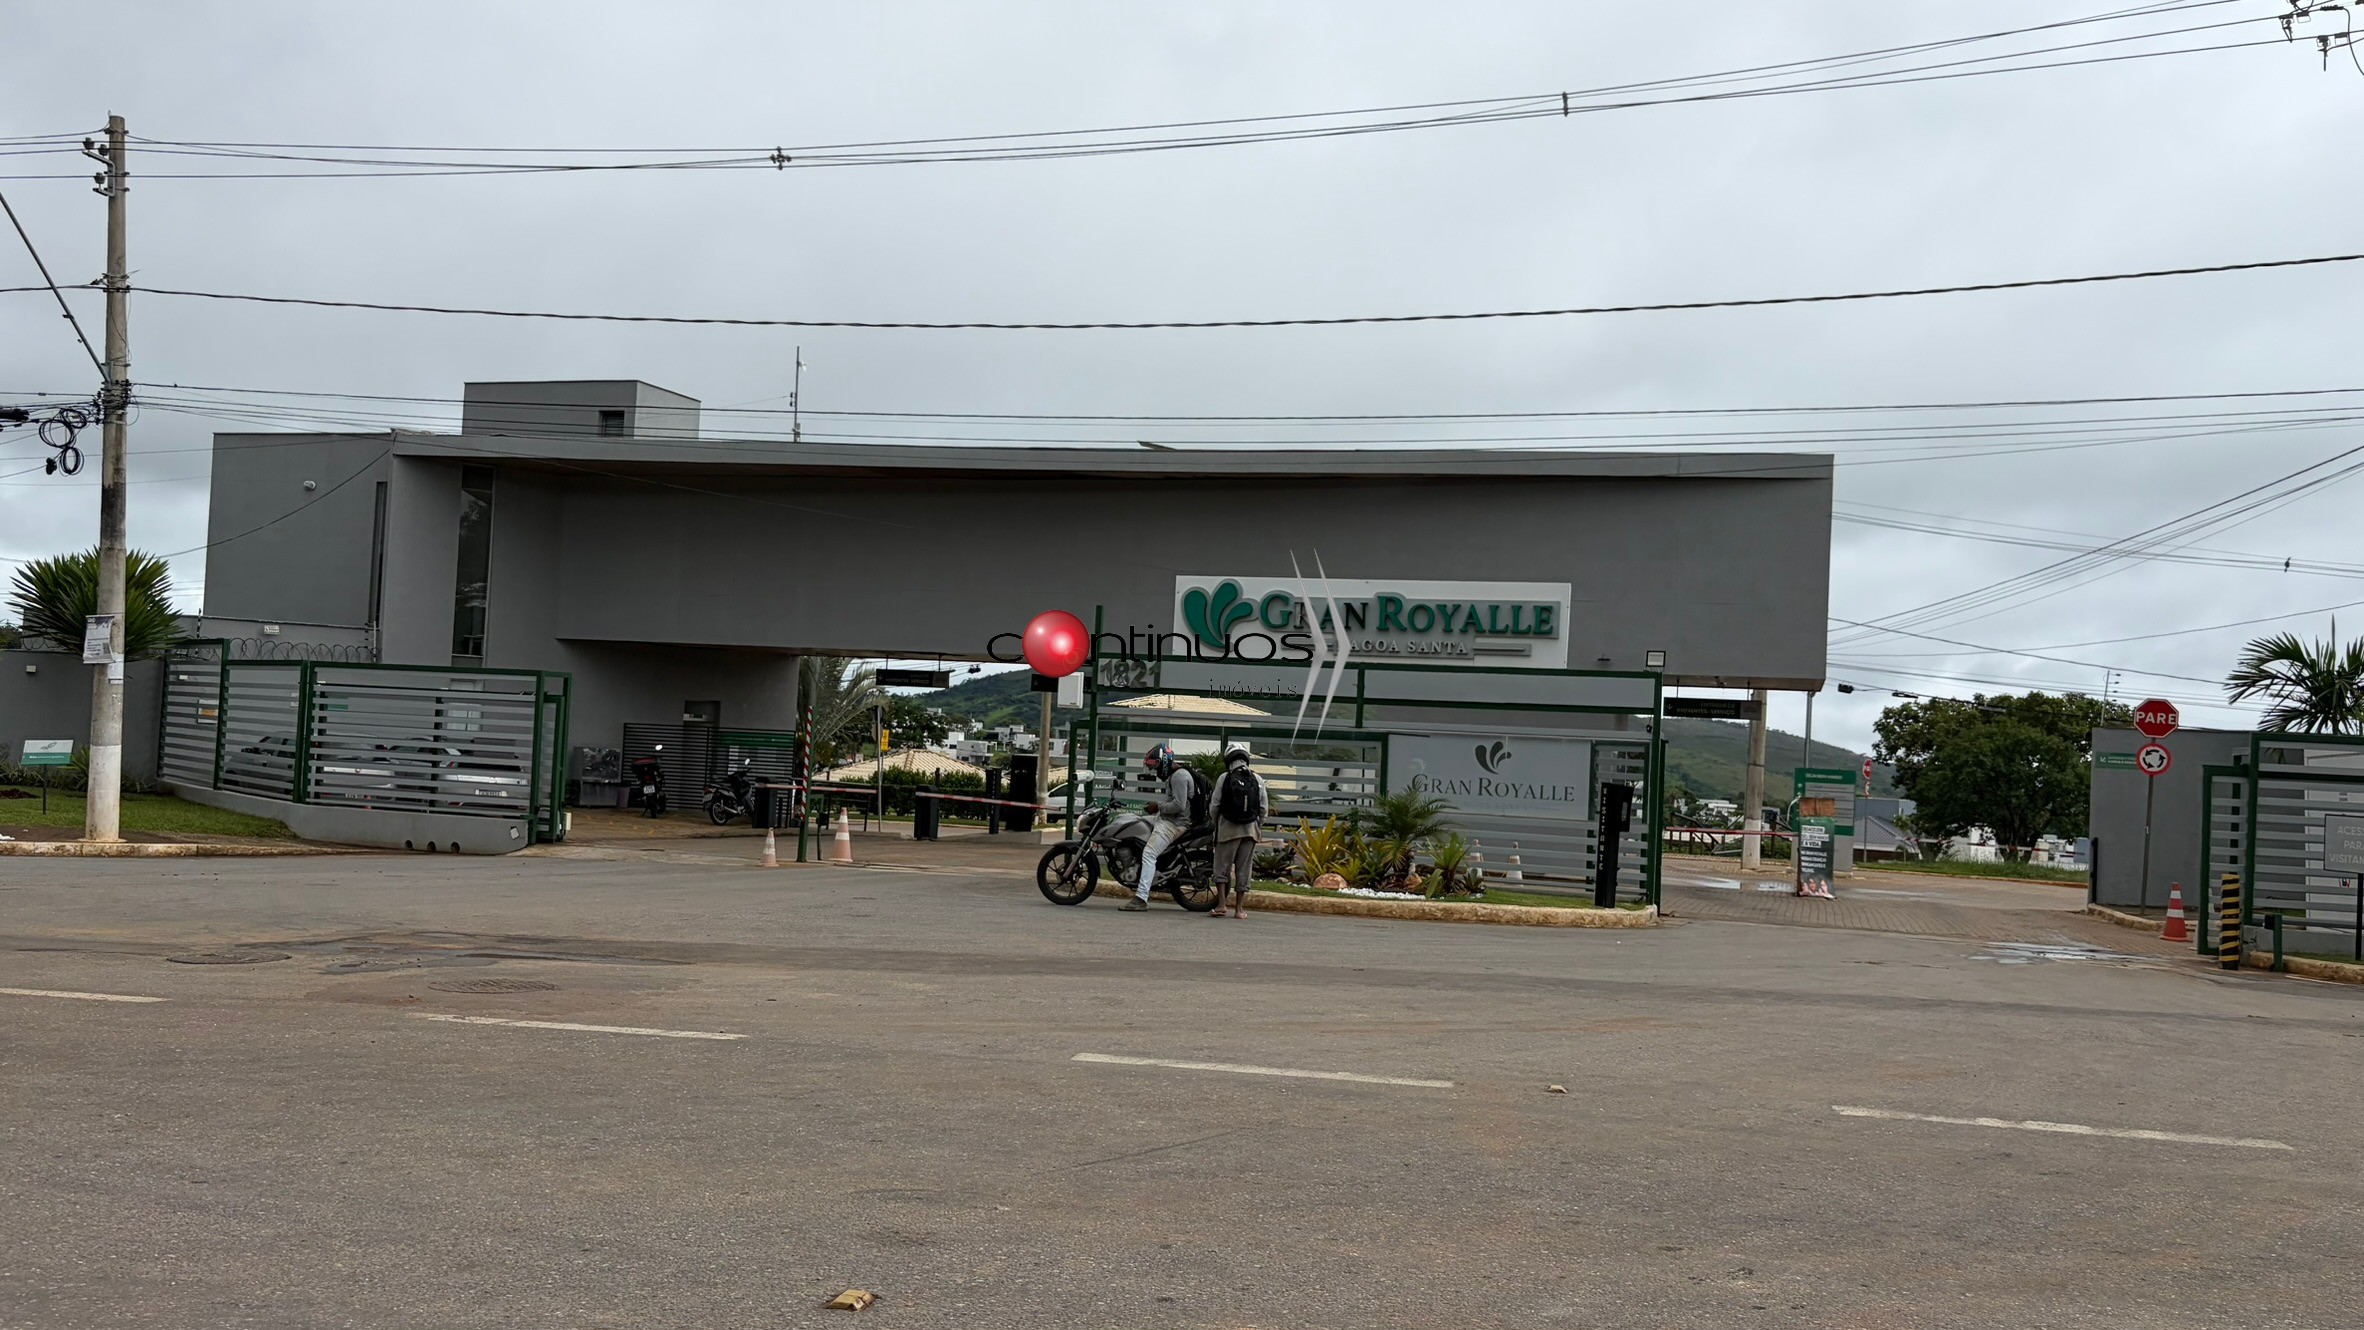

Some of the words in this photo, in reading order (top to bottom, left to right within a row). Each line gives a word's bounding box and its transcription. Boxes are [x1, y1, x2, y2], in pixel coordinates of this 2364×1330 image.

[1260, 593, 1369, 629] GRAN
[1376, 594, 1554, 634] ROYALLE
[1406, 641, 1469, 655] SANTA
[1100, 659, 1161, 689] 1821
[2135, 711, 2177, 726] PARE
[1411, 773, 1472, 796] GRAN
[1478, 777, 1575, 802] ROYALLE
[2343, 840, 2364, 851] PAR
